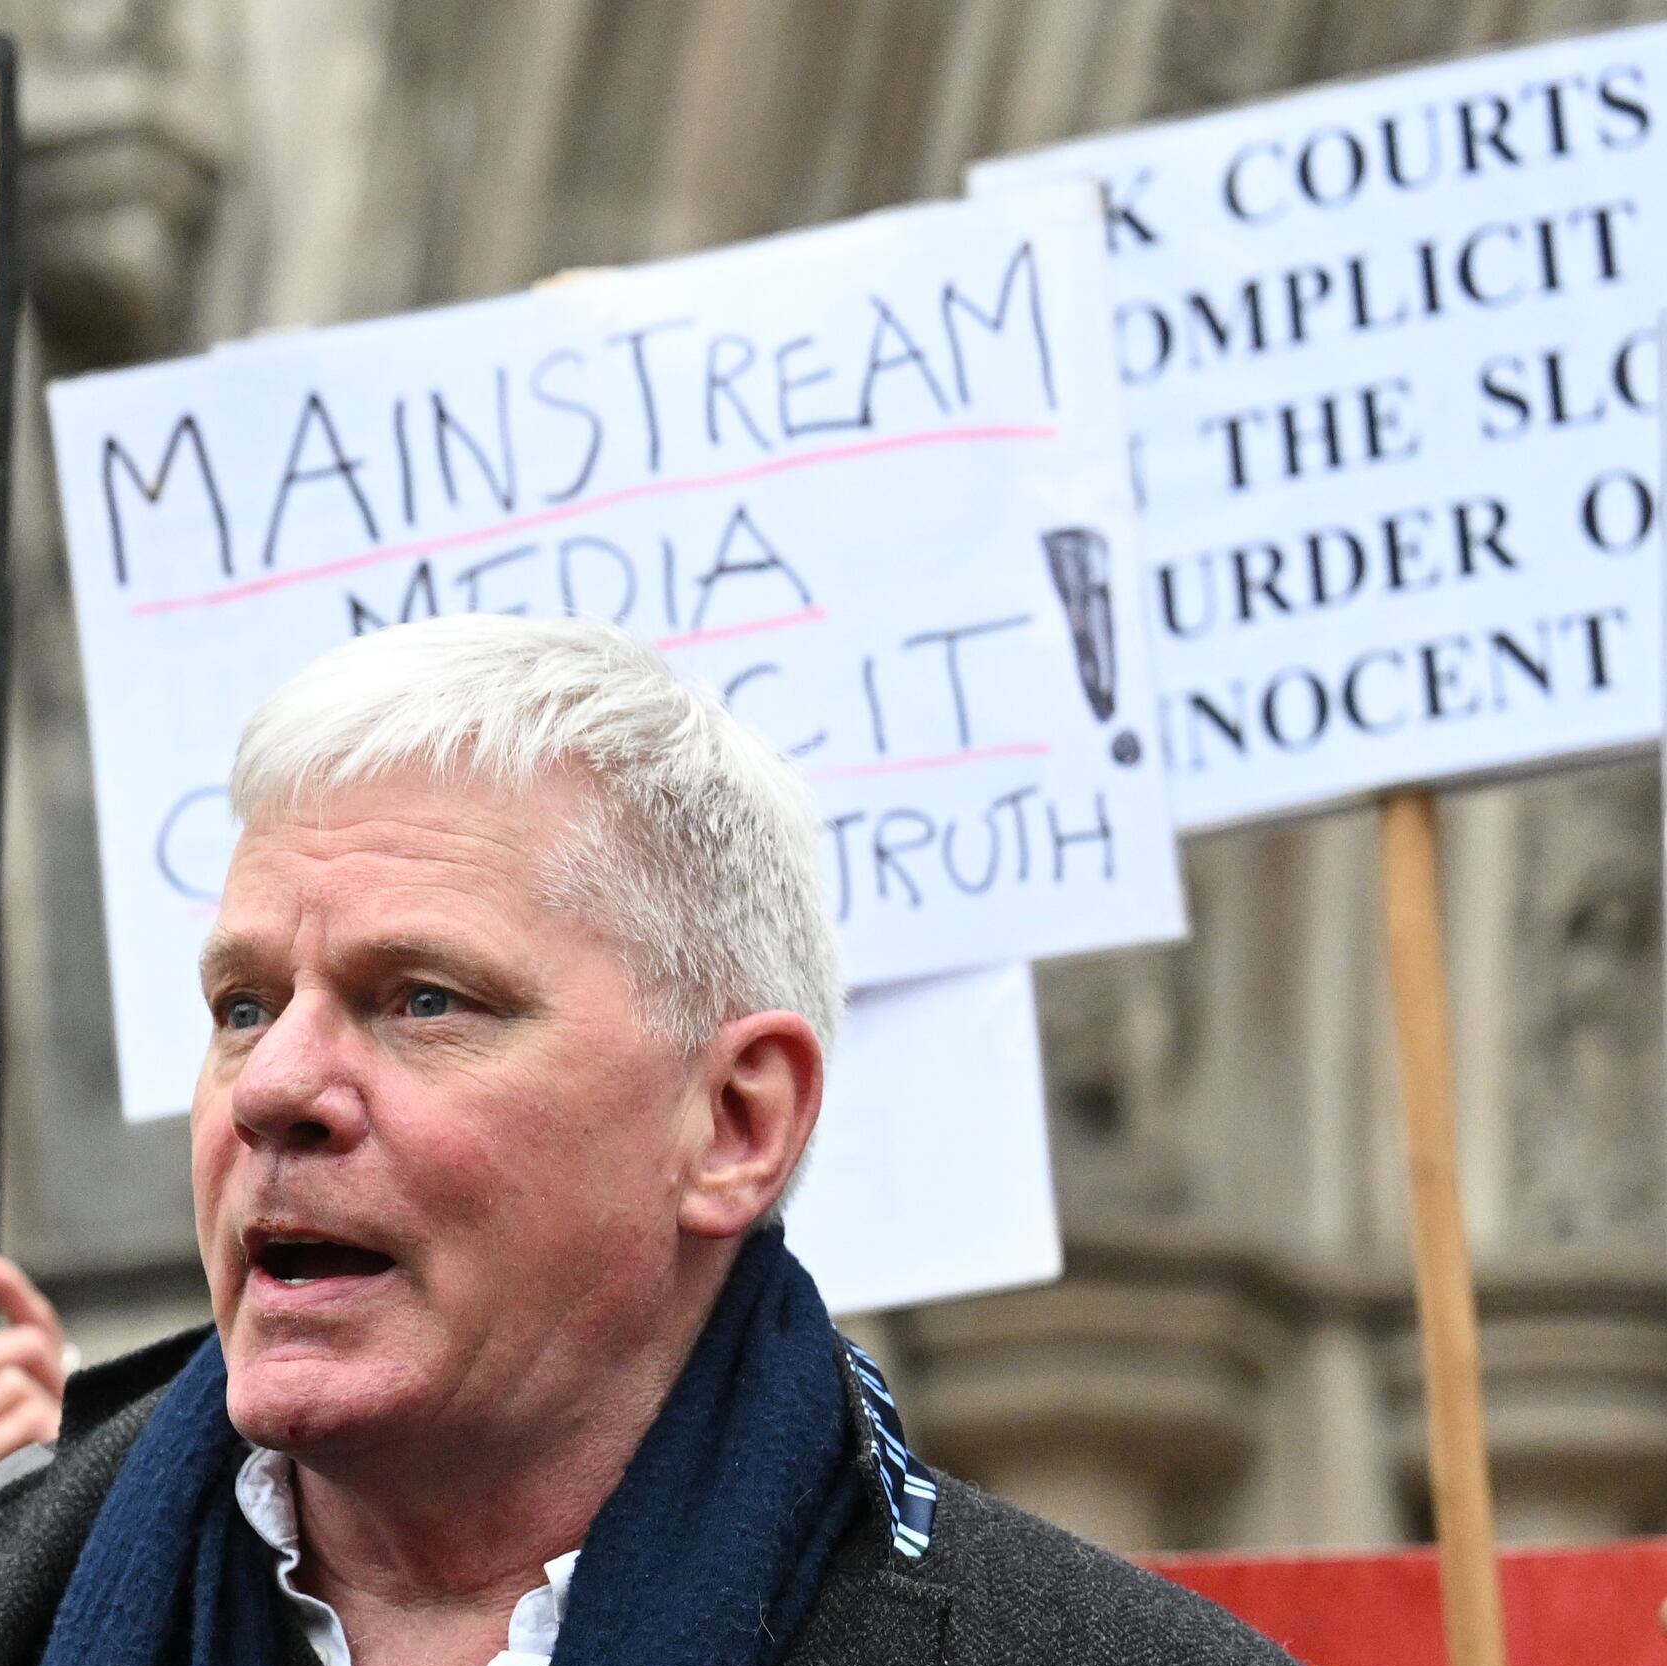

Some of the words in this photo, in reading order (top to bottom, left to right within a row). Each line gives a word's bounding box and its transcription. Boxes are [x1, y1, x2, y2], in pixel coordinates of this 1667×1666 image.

[1222, 62, 1652, 227] COURTS
[103, 240, 1059, 586] MAINSTREAM
[1198, 374, 1423, 490] THE
[345, 502, 815, 640] MEDIA
[1156, 497, 1520, 640] URDER
[822, 783, 1117, 924] TRUTH
